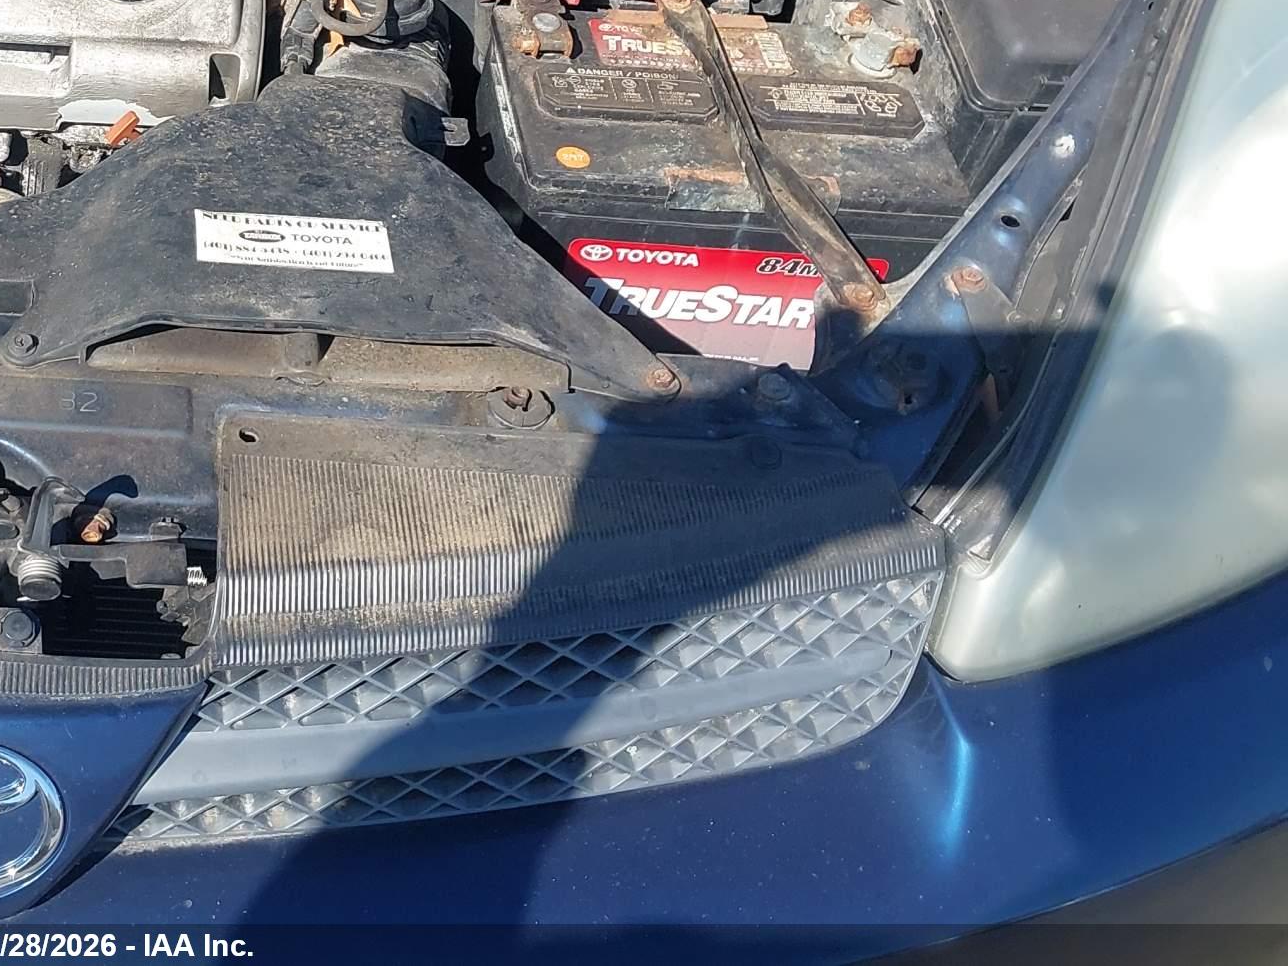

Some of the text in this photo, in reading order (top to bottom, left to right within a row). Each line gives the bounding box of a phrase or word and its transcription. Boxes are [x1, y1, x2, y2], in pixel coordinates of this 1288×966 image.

[577, 67, 624, 78] DANGER
[292, 233, 353, 245] TOYOTA
[615, 247, 700, 267] TOYOTA
